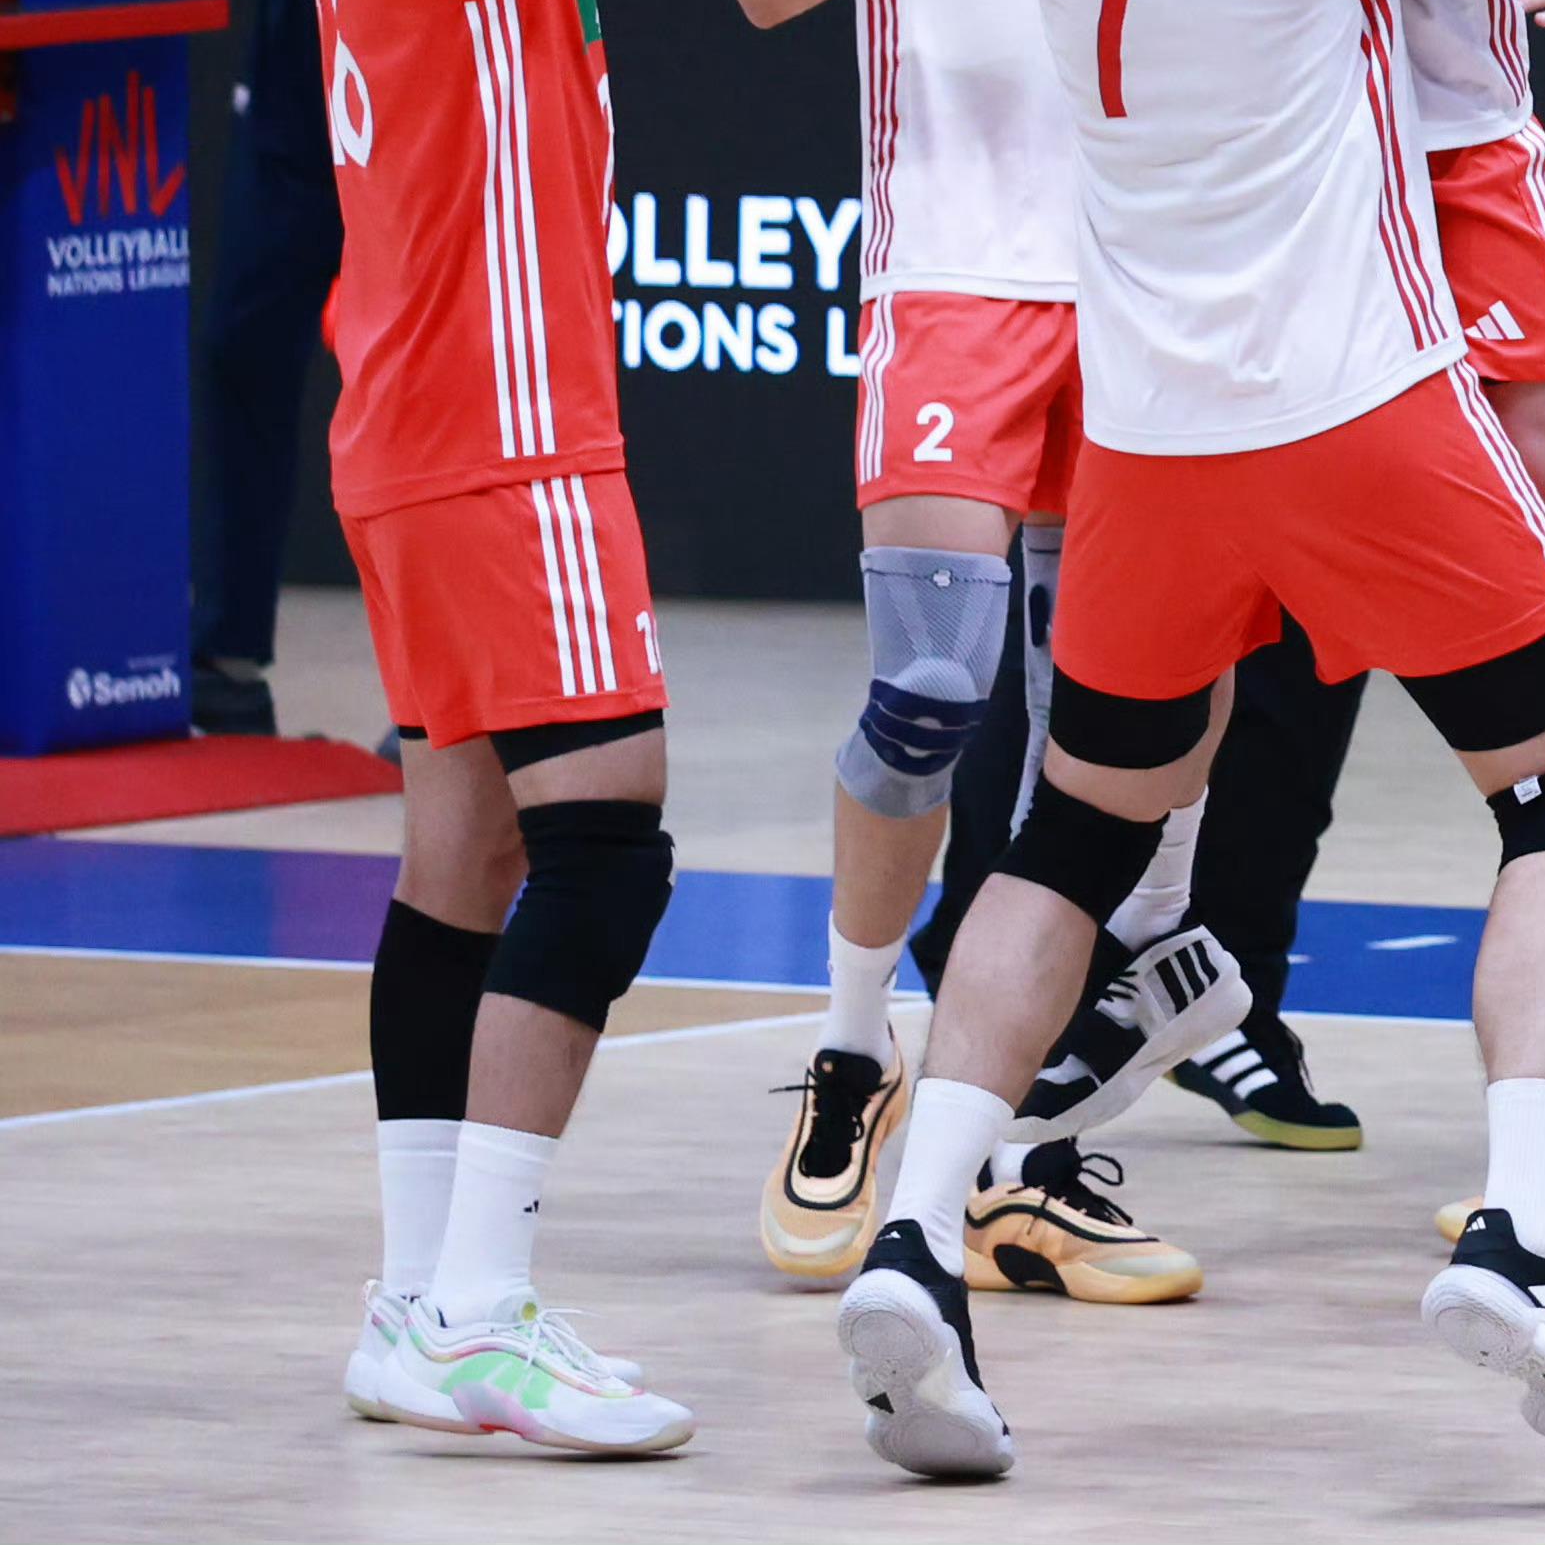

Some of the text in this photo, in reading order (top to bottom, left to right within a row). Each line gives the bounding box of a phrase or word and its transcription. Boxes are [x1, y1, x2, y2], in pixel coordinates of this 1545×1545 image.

[54, 69, 188, 226] VNL
[47, 227, 189, 269] VOLLEYBALL
[47, 269, 124, 297] NATIONS
[913, 402, 954, 462] 2
